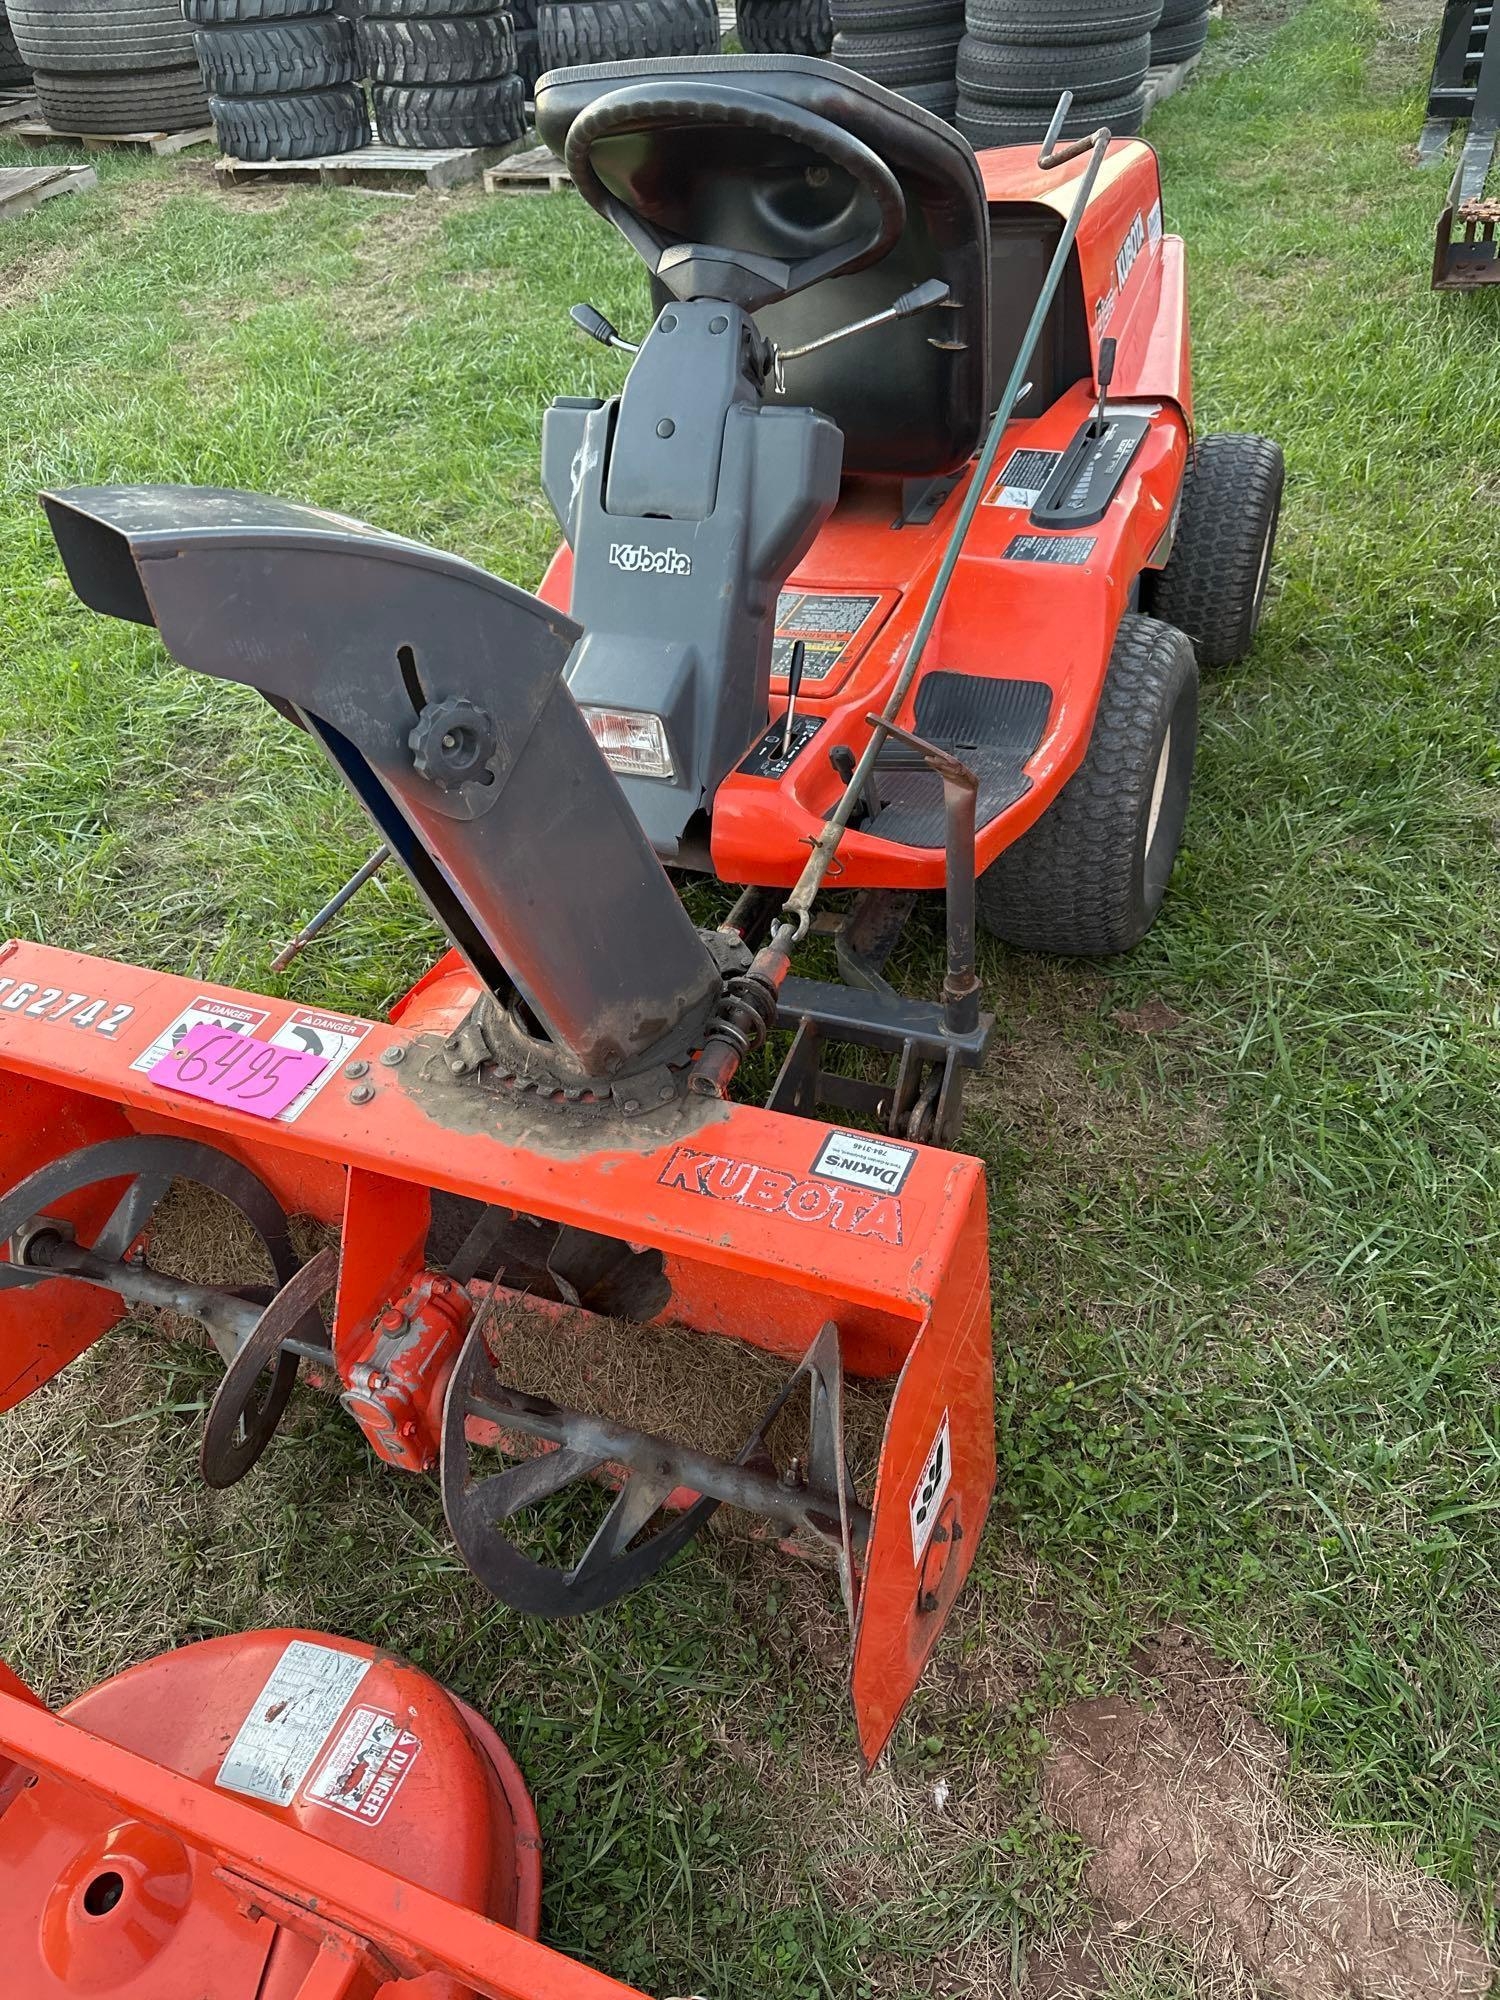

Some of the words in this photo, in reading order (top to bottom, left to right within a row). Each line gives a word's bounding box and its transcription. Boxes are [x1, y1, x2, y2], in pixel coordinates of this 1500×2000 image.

[608, 543, 692, 576] Kubota
[209, 1004, 254, 1021] DANGER
[312, 1017, 358, 1034] DANGER
[176, 1035, 302, 1099] 6495
[853, 1143, 888, 1156] 784-3146
[825, 1155, 899, 1184] DAKIN'S
[656, 1146, 903, 1246] KUBOTA
[360, 1750, 409, 1817] DANGER
